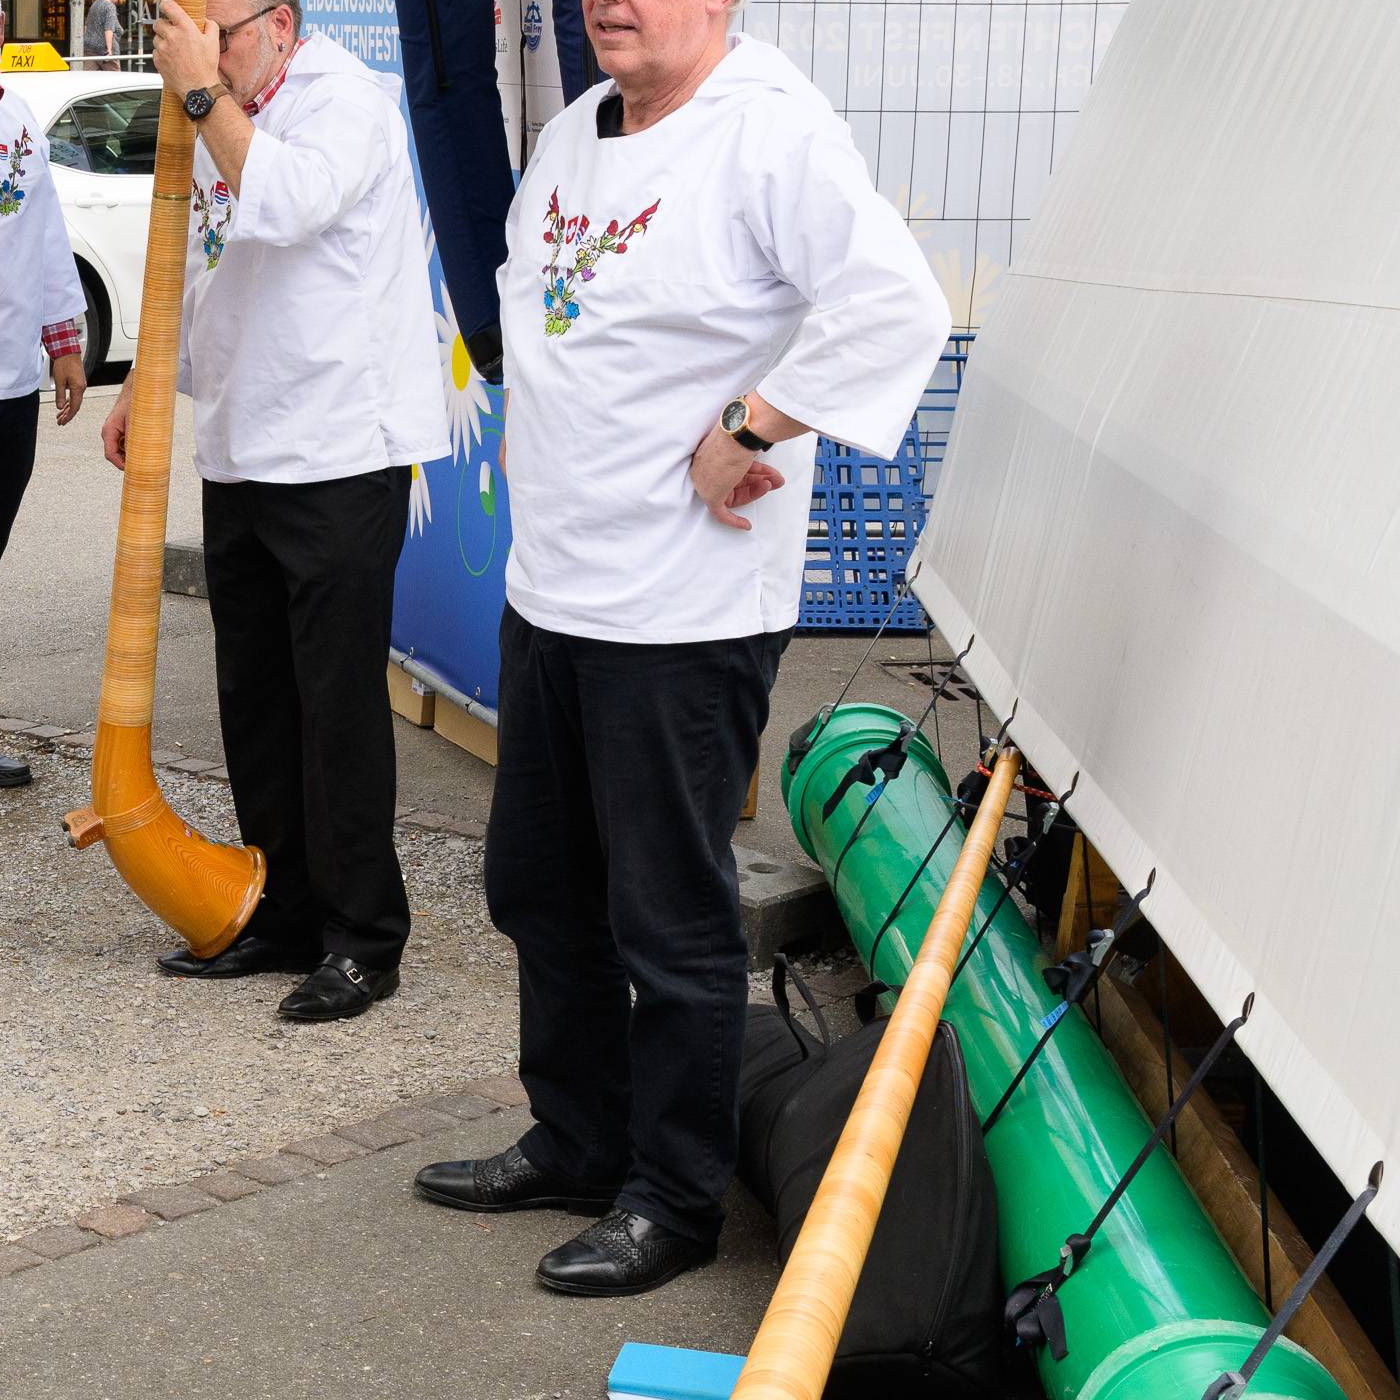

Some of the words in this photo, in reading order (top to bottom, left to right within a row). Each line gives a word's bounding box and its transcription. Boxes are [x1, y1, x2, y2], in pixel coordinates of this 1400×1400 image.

[523, 24, 533, 34] Emil
[533, 24, 543, 35] Frey
[305, 23, 400, 61] HTENFEST
[18, 45, 32, 53] 708
[11, 56, 35, 67] TAXI
